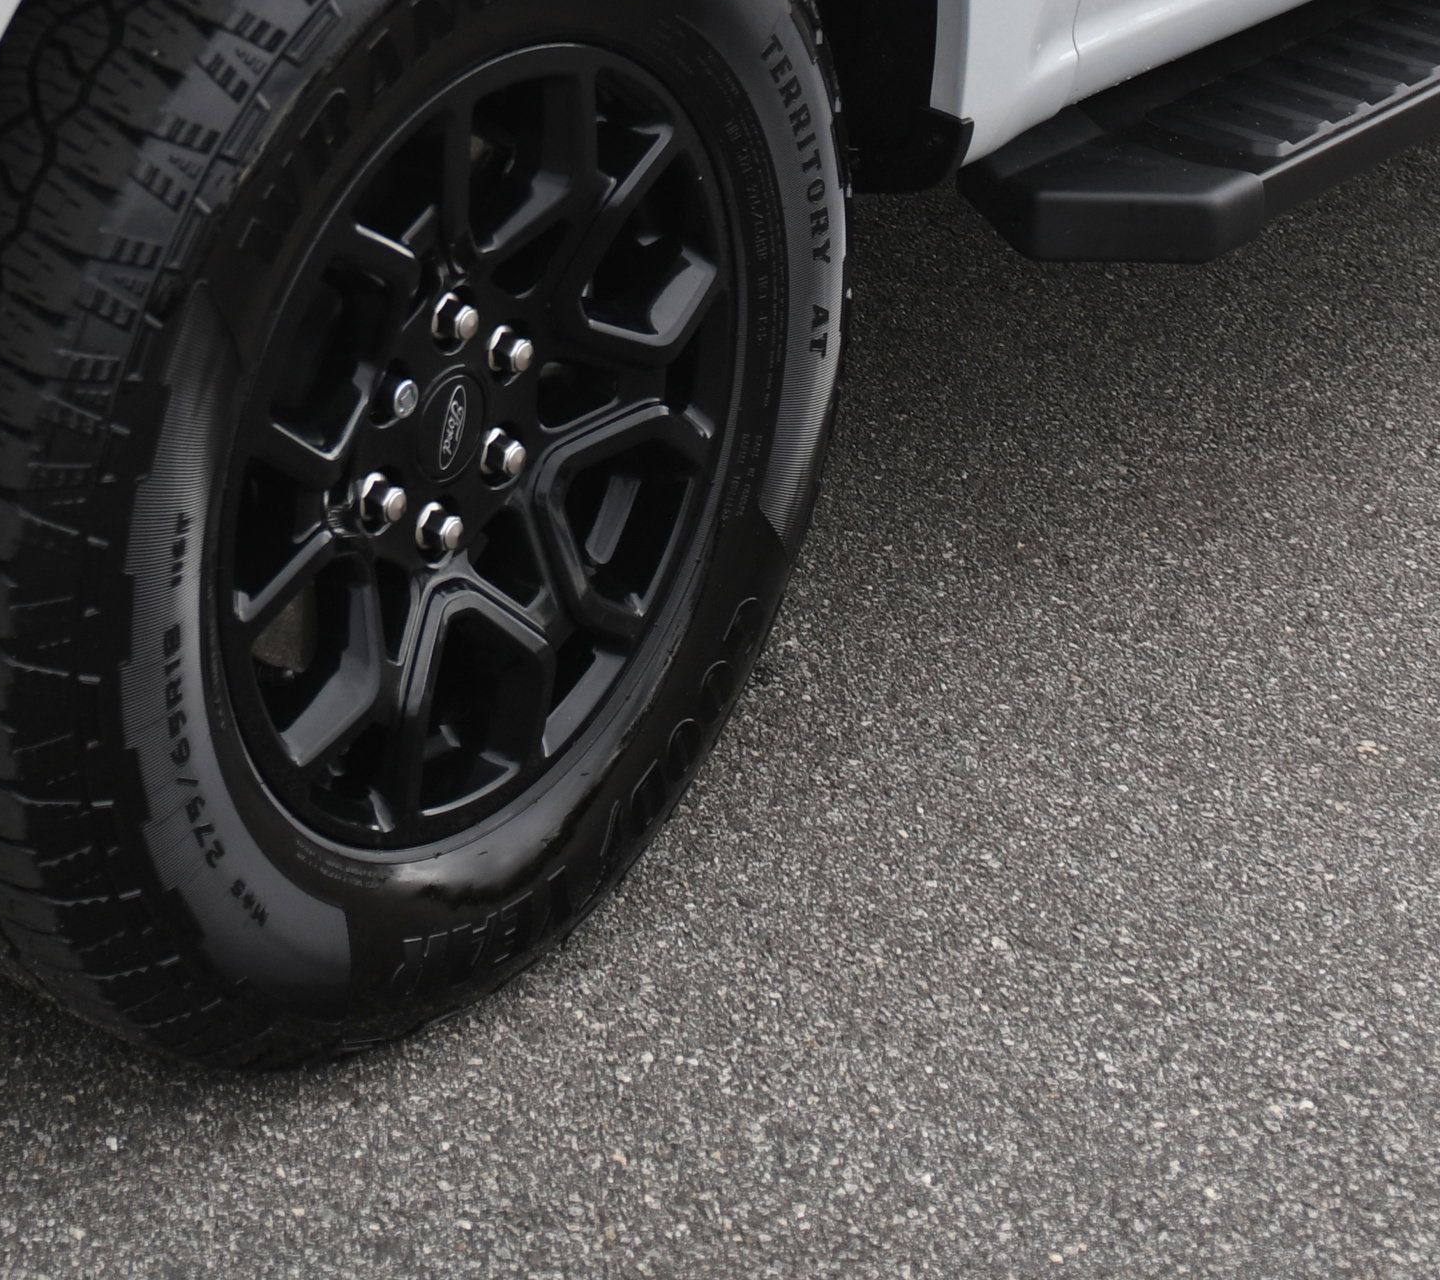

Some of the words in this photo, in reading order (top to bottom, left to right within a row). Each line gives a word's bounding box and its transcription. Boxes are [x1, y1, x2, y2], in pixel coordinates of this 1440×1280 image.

[761, 32, 832, 265] TERRITORY
[810, 304, 831, 359] AT
[442, 400, 465, 456] Ford
[162, 623, 226, 869] 275/65R18
